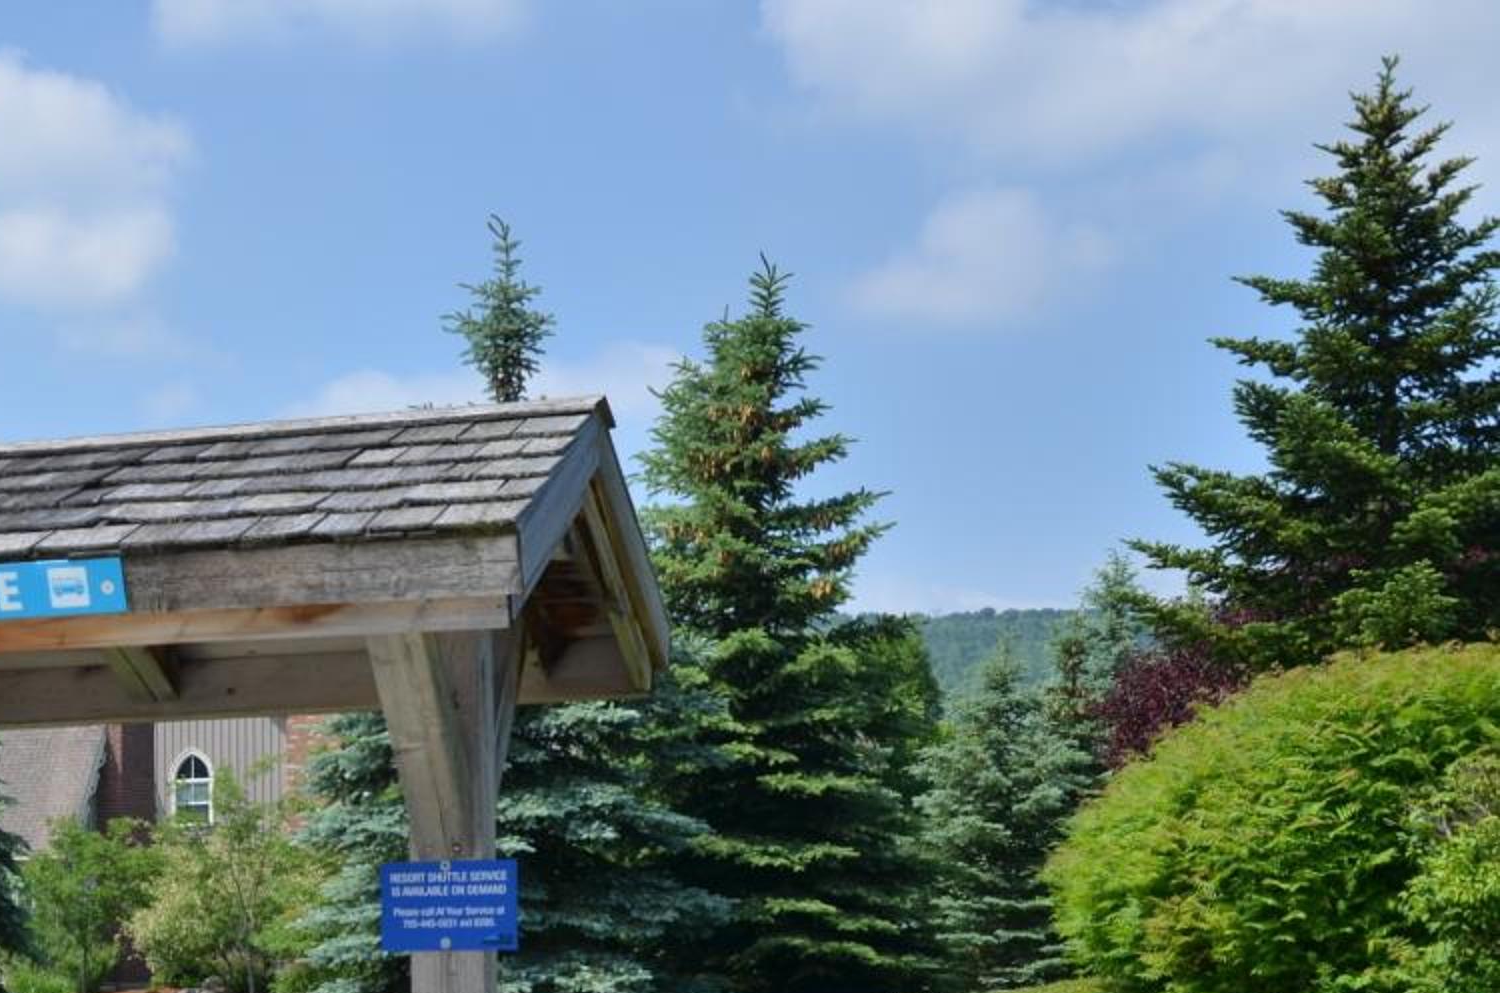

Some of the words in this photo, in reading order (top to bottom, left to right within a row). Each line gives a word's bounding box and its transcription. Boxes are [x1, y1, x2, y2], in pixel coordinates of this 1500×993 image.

[389, 873, 425, 884] RESORT
[427, 871, 467, 883] SHUTTLE
[470, 870, 507, 881] SERVICE
[391, 885, 401, 897] IS
[401, 884, 448, 897] AVAILABLE
[451, 884, 465, 895] ON
[467, 884, 507, 895] DEMAND
